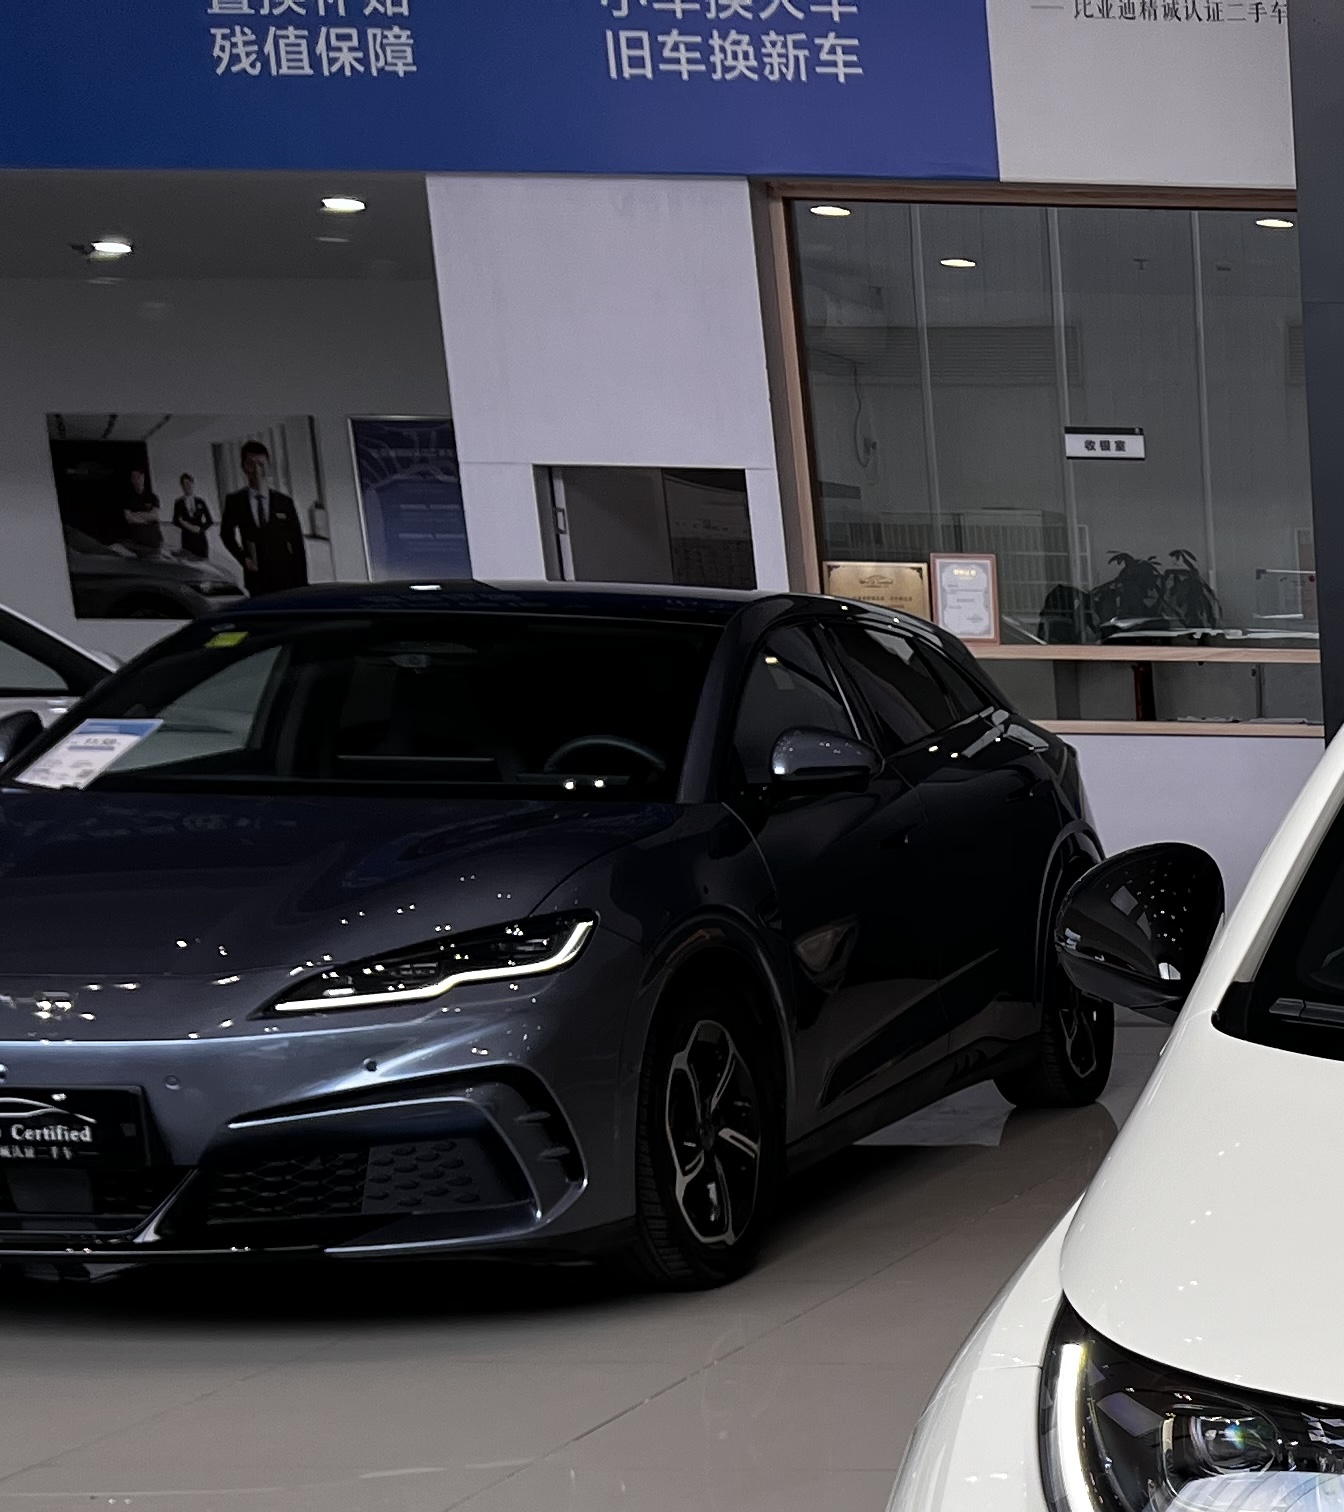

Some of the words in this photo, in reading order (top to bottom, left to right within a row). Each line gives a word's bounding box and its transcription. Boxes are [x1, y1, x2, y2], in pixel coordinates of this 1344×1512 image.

[209, 25, 418, 77] 残值保障
[605, 28, 864, 84] 旧车换新车
[10, 1123, 93, 1142] Certified
